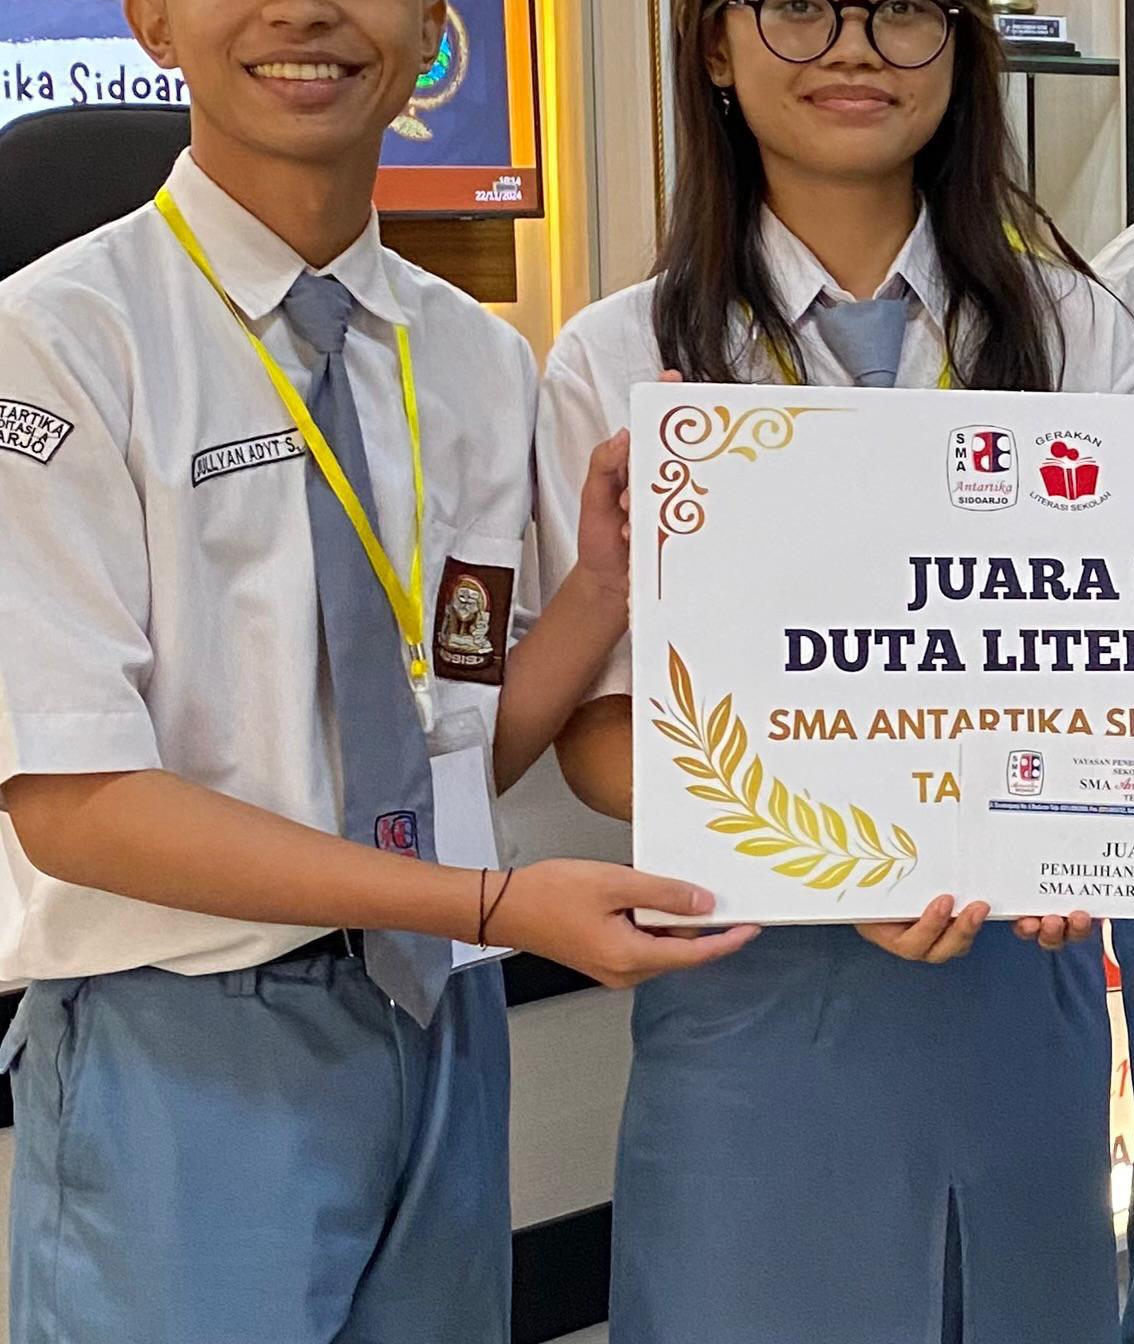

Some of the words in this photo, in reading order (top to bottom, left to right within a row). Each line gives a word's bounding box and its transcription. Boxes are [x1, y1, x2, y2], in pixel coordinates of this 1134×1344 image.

[3, 61, 54, 102] ika
[1035, 430, 1103, 448] GERAKAN
[952, 480, 1013, 495] Antartika
[958, 496, 1009, 505] SIDOARJO
[1029, 490, 1069, 512] LITERASI
[1070, 491, 1112, 512] SEKOLAH
[907, 556, 1120, 612] JUARA
[784, 628, 966, 673] DUTA
[767, 708, 858, 741] SMA
[867, 707, 1093, 741] ANTARTIKA
[1079, 778, 1112, 790] SMA
[1040, 862, 1134, 879] PEMILIHAN
[1039, 882, 1075, 896] SMA
